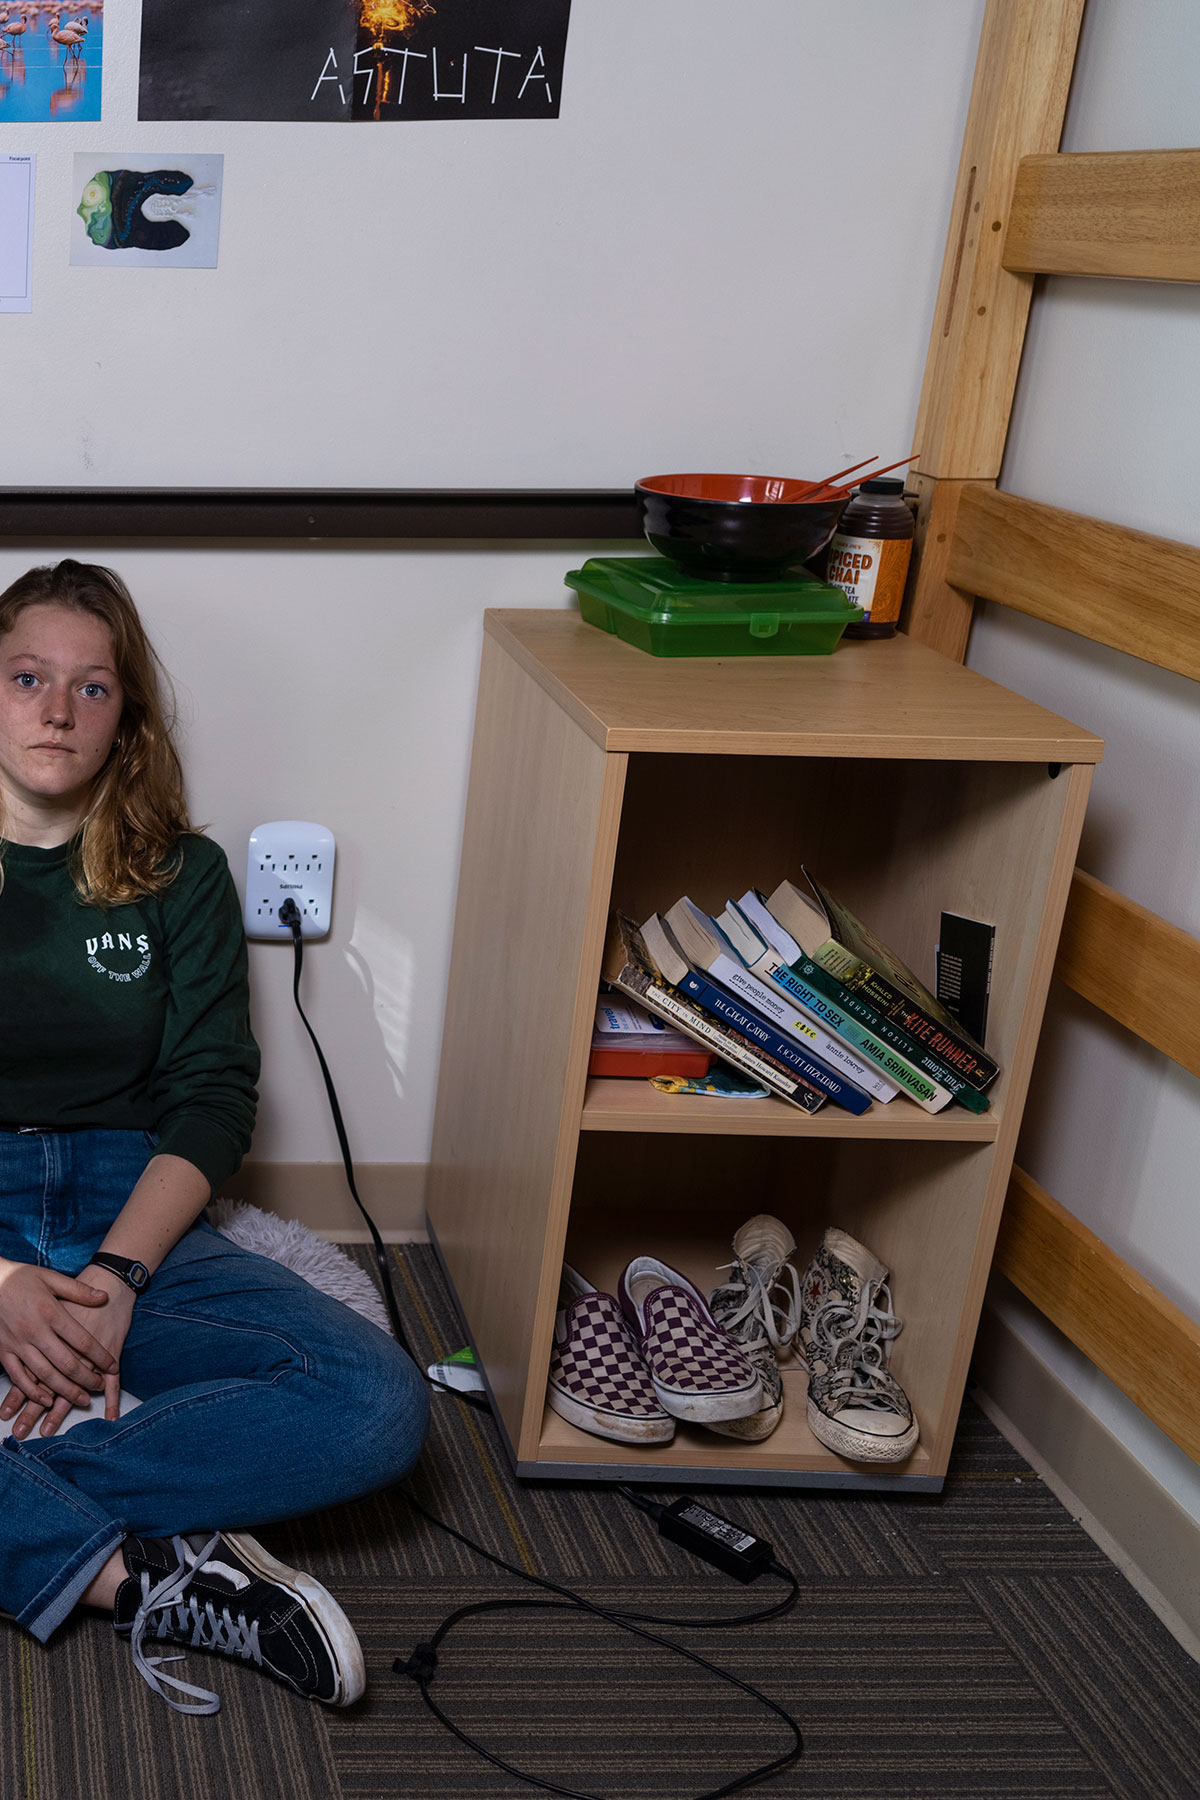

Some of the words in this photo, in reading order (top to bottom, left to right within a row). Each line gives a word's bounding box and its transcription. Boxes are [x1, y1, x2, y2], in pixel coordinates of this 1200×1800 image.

[311, 46, 552, 105] ASTUTA
[829, 549, 872, 570] PICED
[829, 566, 860, 584] CHAI
[844, 586, 855, 595] TEA
[85, 931, 150, 956] VANS
[87, 955, 107, 974] OFF
[108, 970, 132, 982] THE
[131, 952, 152, 979] WALL
[732, 973, 748, 986] give
[746, 983, 767, 1001] people
[765, 997, 785, 1014] money
[768, 962, 788, 982] THE
[785, 978, 817, 1003] RIGHT
[814, 998, 828, 1013] TO
[825, 1008, 845, 1028] SEX
[862, 984, 890, 1008] HOSSEINI
[870, 981, 893, 1000] KHALED
[662, 997, 682, 1014] CITY
[690, 1016, 712, 1035] MIND
[839, 990, 878, 1025] BECHDEL
[881, 1026, 915, 1054] ALISON
[903, 1012, 936, 1041] KITE
[928, 1032, 978, 1075] RUNNER
[783, 1047, 807, 1067] SCOTT
[825, 1043, 845, 1059] annie
[844, 1056, 865, 1074] lowrey
[860, 1039, 886, 1062] AMIA
[883, 1057, 938, 1102] SRINIVASAN
[921, 1056, 948, 1082] Home
[944, 1075, 966, 1097] Fun
